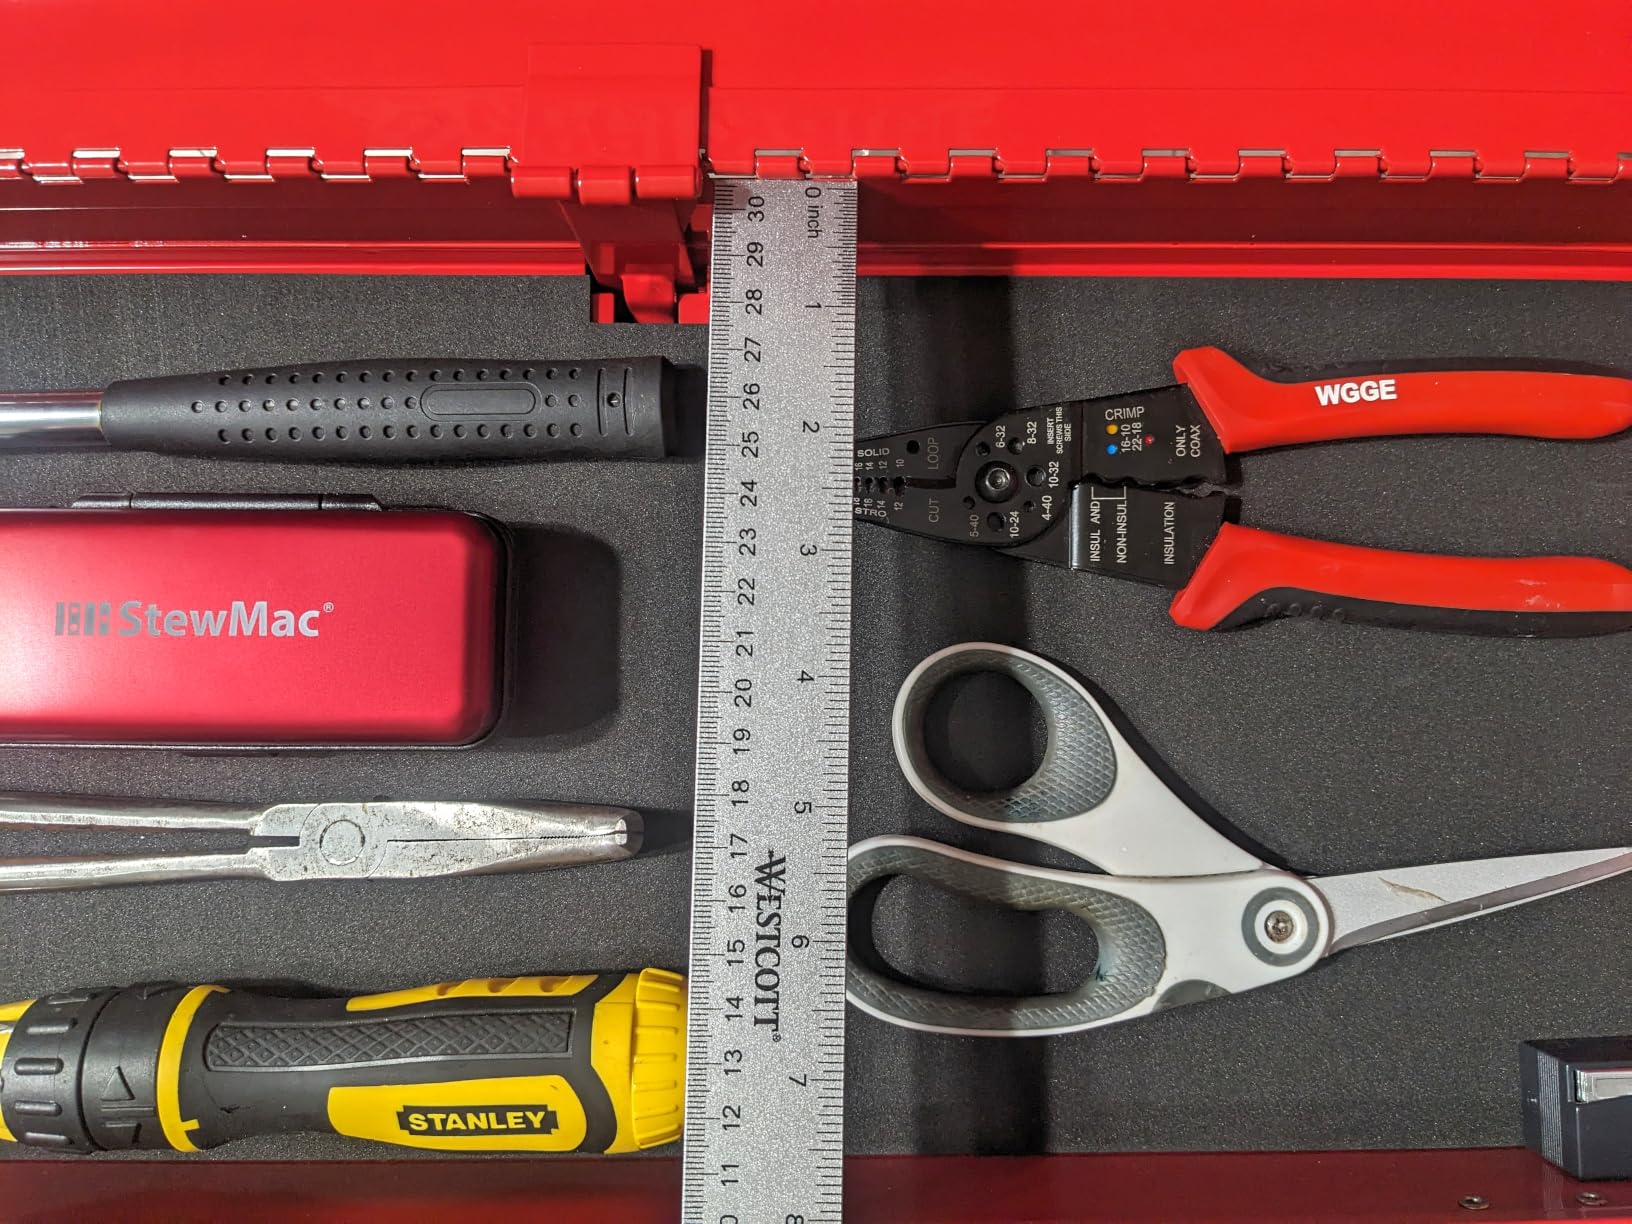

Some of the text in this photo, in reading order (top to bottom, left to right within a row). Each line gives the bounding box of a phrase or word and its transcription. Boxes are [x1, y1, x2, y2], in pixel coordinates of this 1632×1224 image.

[748, 196, 765, 222] 30
[805, 186, 823, 239] 0 inch
[747, 242, 764, 267] 29
[745, 288, 763, 315] 28
[744, 337, 761, 362] 27
[743, 383, 760, 410] 26
[1314, 379, 1397, 406] WGGE
[1104, 406, 1145, 421] CRIMP
[802, 421, 820, 433] 2
[995, 425, 1006, 448] 6-32
[1026, 421, 1037, 445] 8-32
[1121, 424, 1131, 452] 16-10
[1132, 422, 1142, 451] 22-18
[741, 431, 759, 458] 25
[857, 448, 890, 457] SOLID
[928, 437, 939, 470] LOOP
[1176, 425, 1186, 457] ONLY
[1190, 424, 1201, 458] COAX
[865, 462, 874, 471] 14
[879, 460, 887, 469] 12
[896, 459, 904, 468] 10
[1049, 461, 1059, 489] 10-32
[740, 479, 758, 507] 24
[877, 500, 886, 509] 14
[894, 501, 904, 510] 12
[928, 498, 939, 523] CUT
[1041, 495, 1052, 521] 4-40
[969, 514, 980, 537] 5-40
[1009, 511, 1020, 538] 10-24
[1090, 500, 1100, 562] INSUL AND
[1117, 500, 1127, 563] NON-INSUL
[1163, 501, 1175, 565] INSULATION
[739, 528, 757, 556] 23
[800, 544, 818, 556] 3
[738, 578, 755, 606] 22
[736, 631, 754, 657] 21
[797, 669, 815, 684] 4
[734, 679, 752, 708] 20
[733, 728, 751, 754] 19
[731, 779, 750, 806] 18
[794, 801, 812, 814] 5
[729, 833, 748, 859] 17
[728, 884, 747, 912] 16
[726, 939, 745, 966] 15
[791, 934, 810, 949] 6
[725, 996, 744, 1021] 14
[724, 1049, 742, 1076] 13
[789, 1073, 807, 1087] 7
[408, 1111, 546, 1131] STANLEY
[722, 1105, 741, 1131] 12
[721, 1164, 739, 1186] 11
